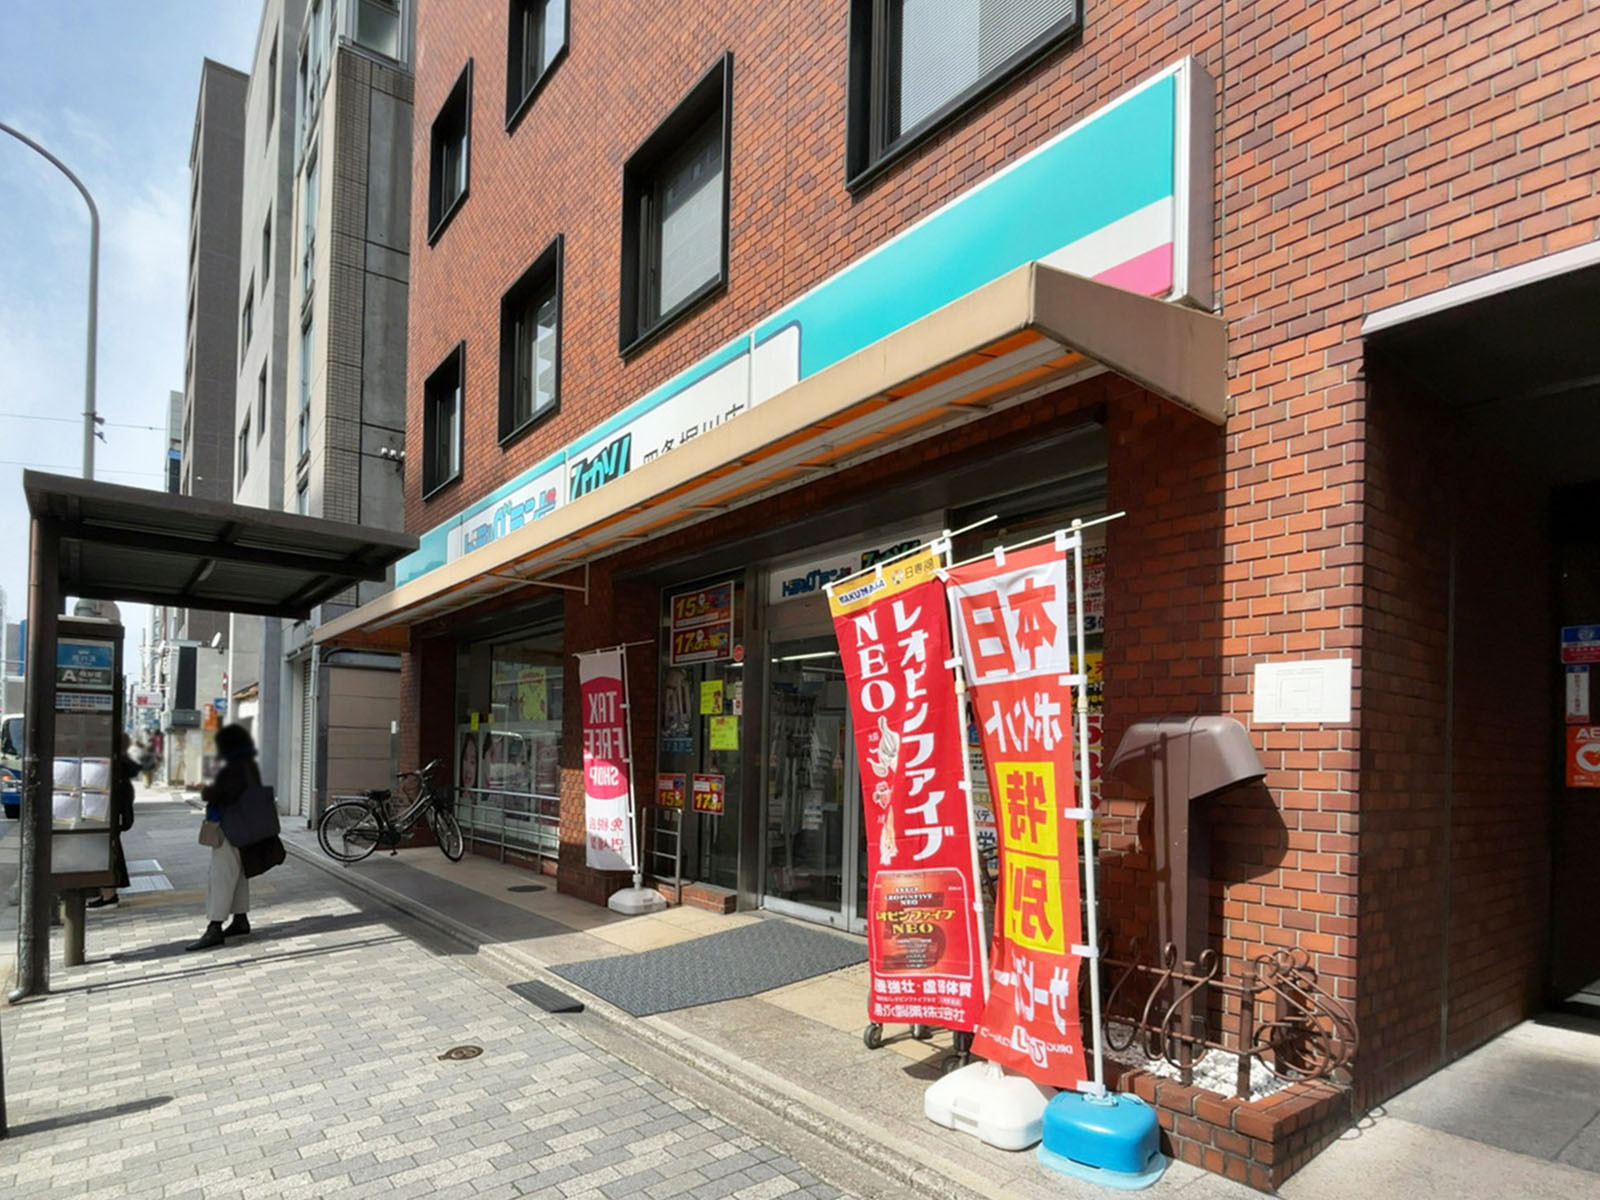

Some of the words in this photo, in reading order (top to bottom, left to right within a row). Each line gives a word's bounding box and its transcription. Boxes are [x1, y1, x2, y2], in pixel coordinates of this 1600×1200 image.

[61, 669, 78, 682] A
[852, 610, 896, 714] NEO
[892, 599, 955, 862] レオピンファイブ
[891, 922, 934, 935] NEO
